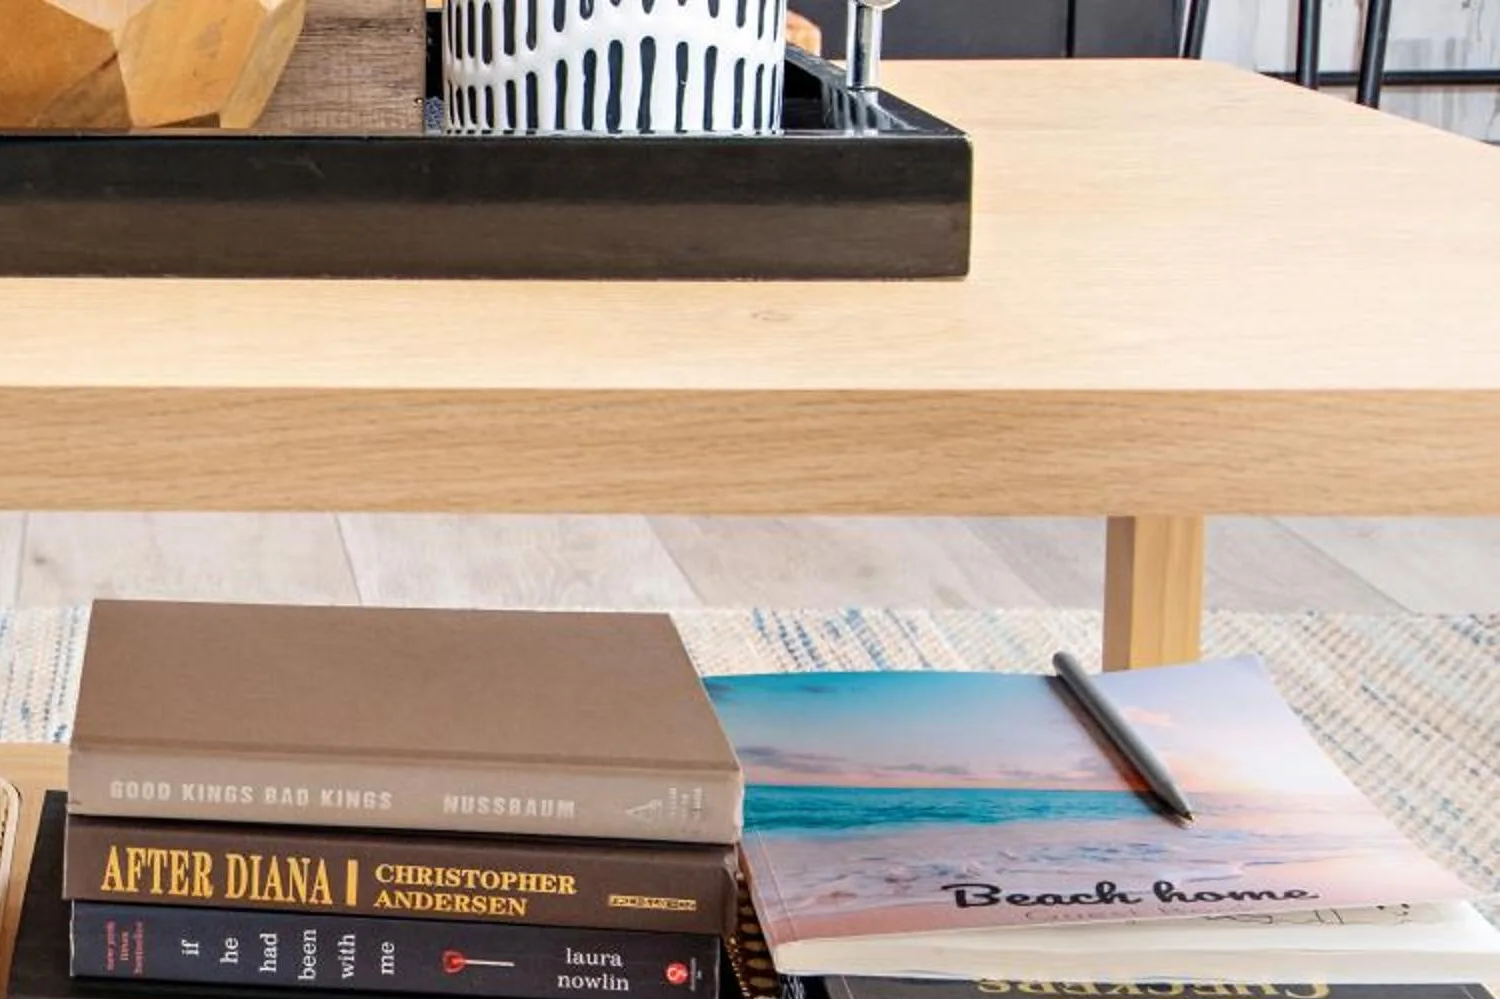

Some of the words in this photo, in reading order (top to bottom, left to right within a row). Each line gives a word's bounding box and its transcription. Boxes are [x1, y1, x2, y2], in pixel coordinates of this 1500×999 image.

[109, 780, 172, 801] GOOD
[181, 783, 254, 805] KINGS
[264, 787, 310, 807] BAD
[320, 788, 394, 811] KINGS
[442, 794, 576, 819] NUSSBAUM
[100, 845, 215, 899] AFTER
[225, 853, 334, 905] DIANA
[374, 863, 578, 895] CHRISTOPHER
[373, 889, 528, 917] ANDERSEN
[941, 881, 1142, 909] Beach
[1152, 880, 1320, 903] home
[181, 939, 199, 956] if
[220, 936, 239, 964] he
[259, 932, 277, 973] had
[297, 929, 317, 981] been
[337, 933, 356, 979] with
[380, 941, 395, 976] me
[565, 947, 624, 968] laura
[557, 972, 630, 991] nowlin
